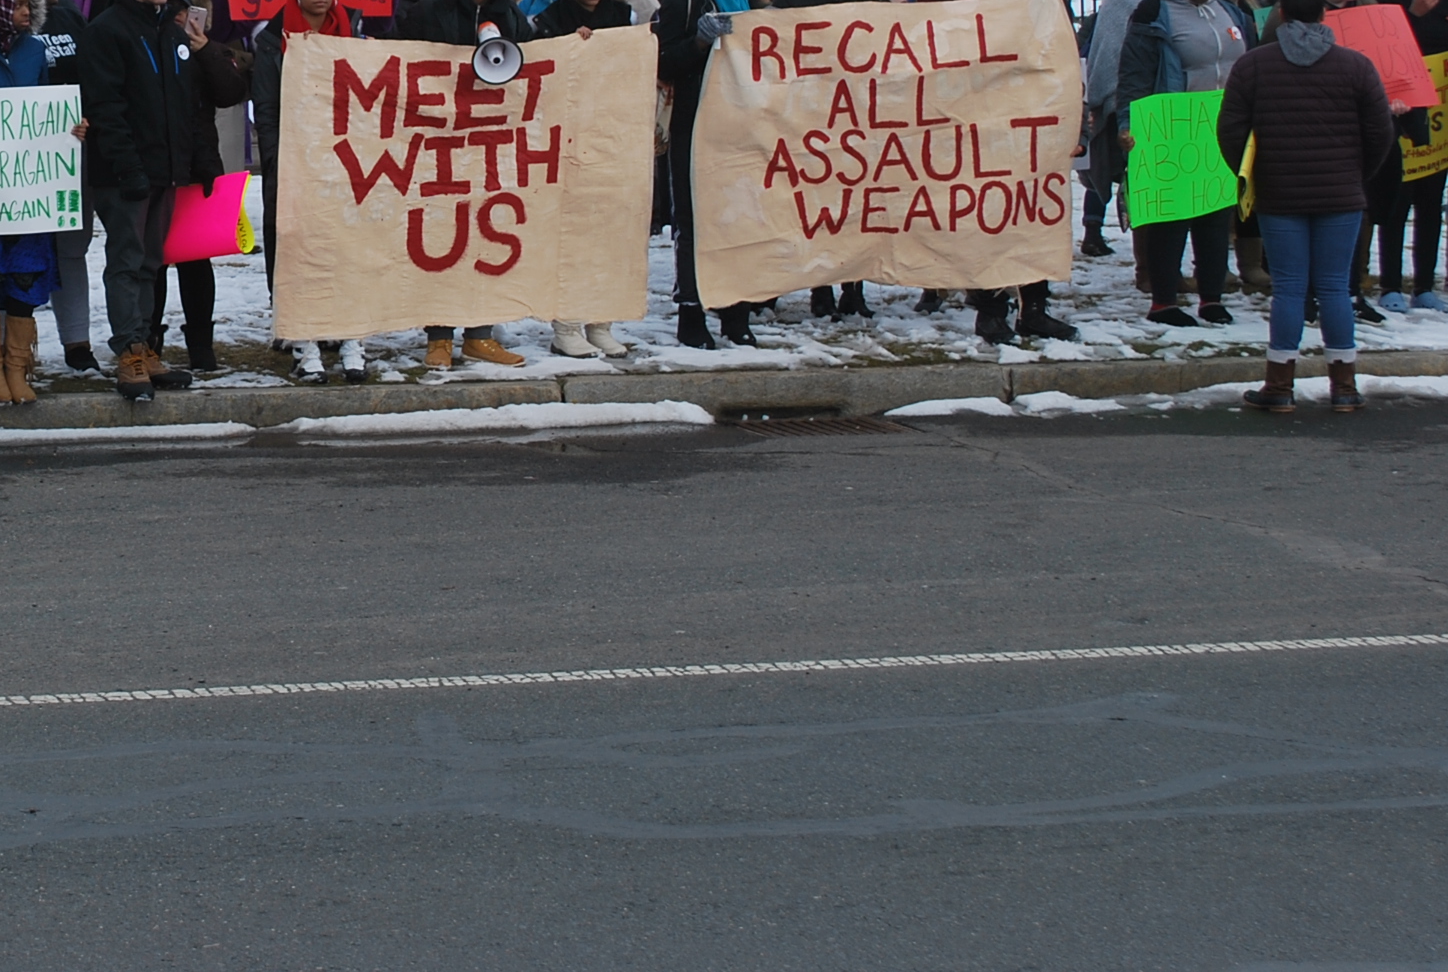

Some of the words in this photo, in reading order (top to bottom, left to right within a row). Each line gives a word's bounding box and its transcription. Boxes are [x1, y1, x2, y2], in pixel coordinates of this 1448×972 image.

[42, 33, 74, 47] Teen
[751, 13, 1019, 82] RECALL
[332, 55, 556, 140] MEET
[827, 75, 951, 129] ALL
[1138, 93, 1224, 142] WHA
[332, 125, 562, 205] WITH
[764, 116, 1059, 189] ASSAULT
[1135, 142, 1221, 182] ABOU
[794, 172, 1066, 240] WEAPONS
[1133, 187, 1176, 218] THE
[1192, 173, 1238, 214] HOO
[406, 191, 527, 277] US
